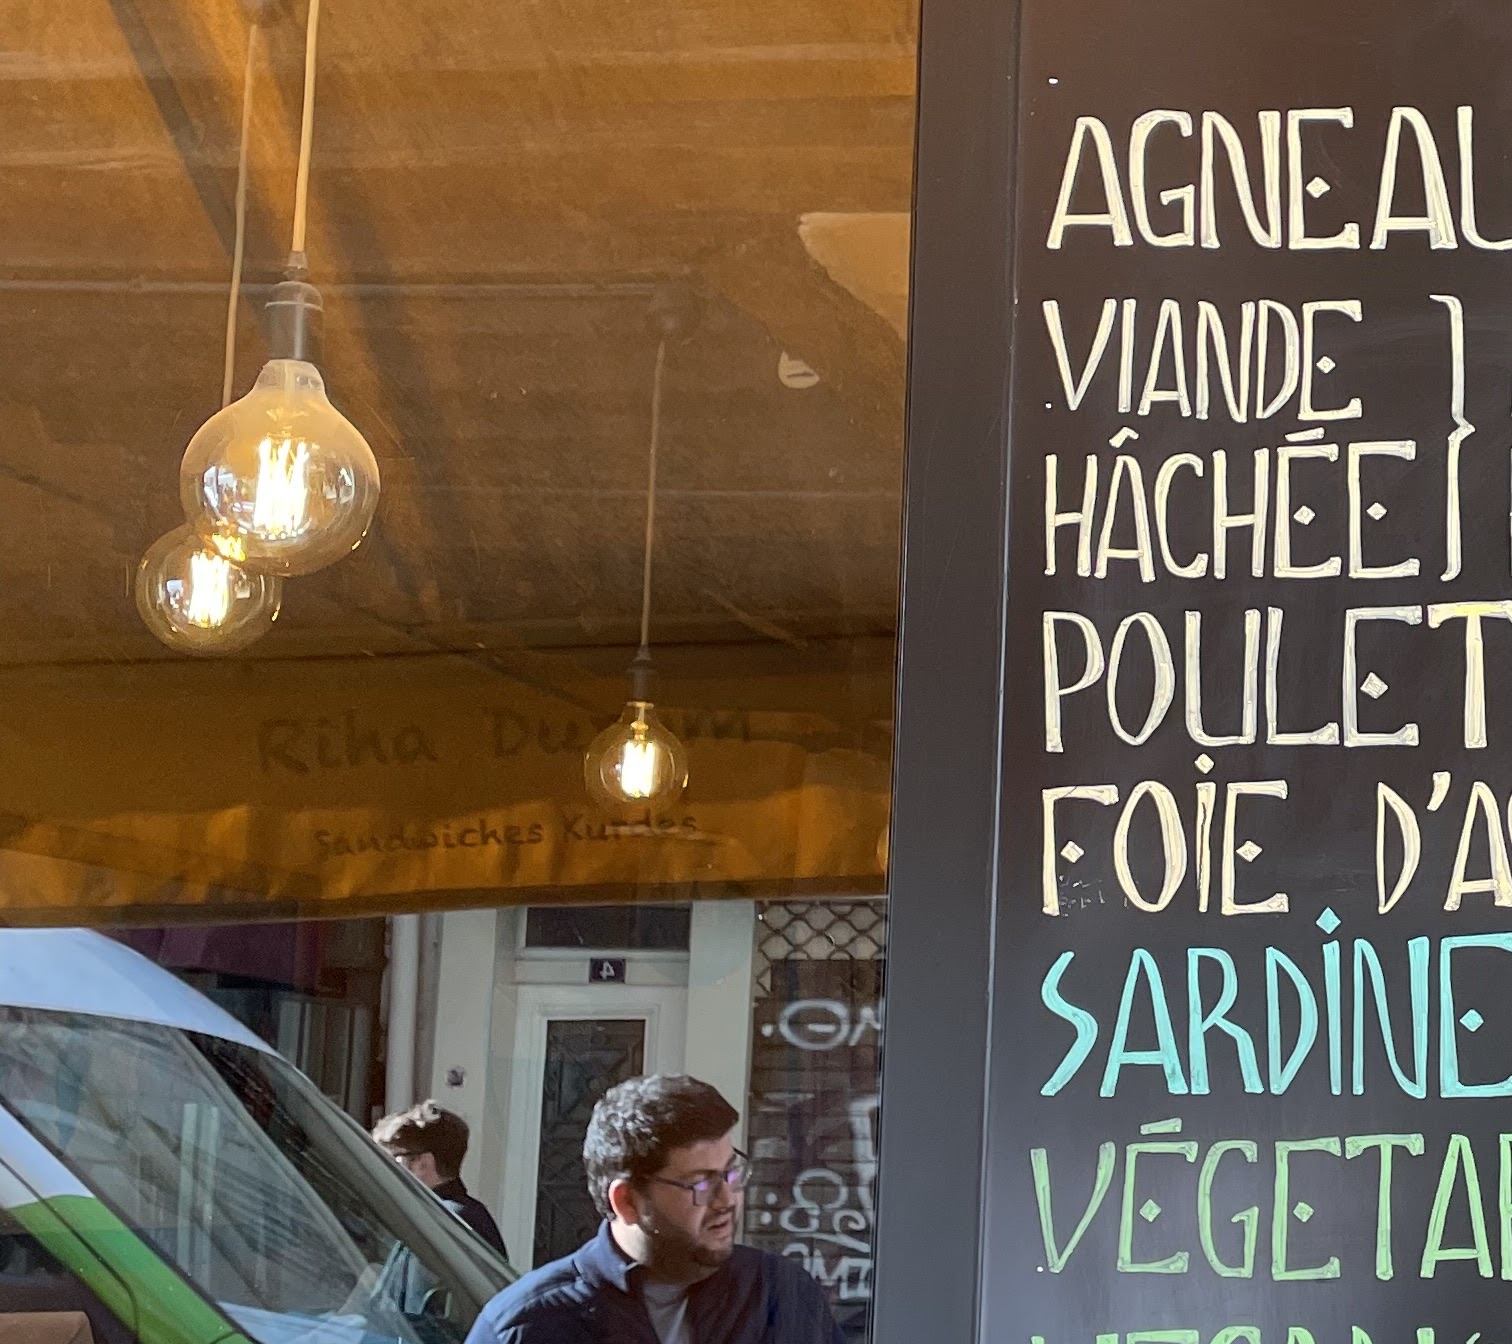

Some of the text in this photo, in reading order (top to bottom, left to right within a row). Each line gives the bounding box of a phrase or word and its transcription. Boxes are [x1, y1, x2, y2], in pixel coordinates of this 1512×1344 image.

[1043, 297, 1362, 422] VIANDE
[1042, 426, 1421, 583] HÂCHÉE
[1042, 752, 1289, 917] FOIE
